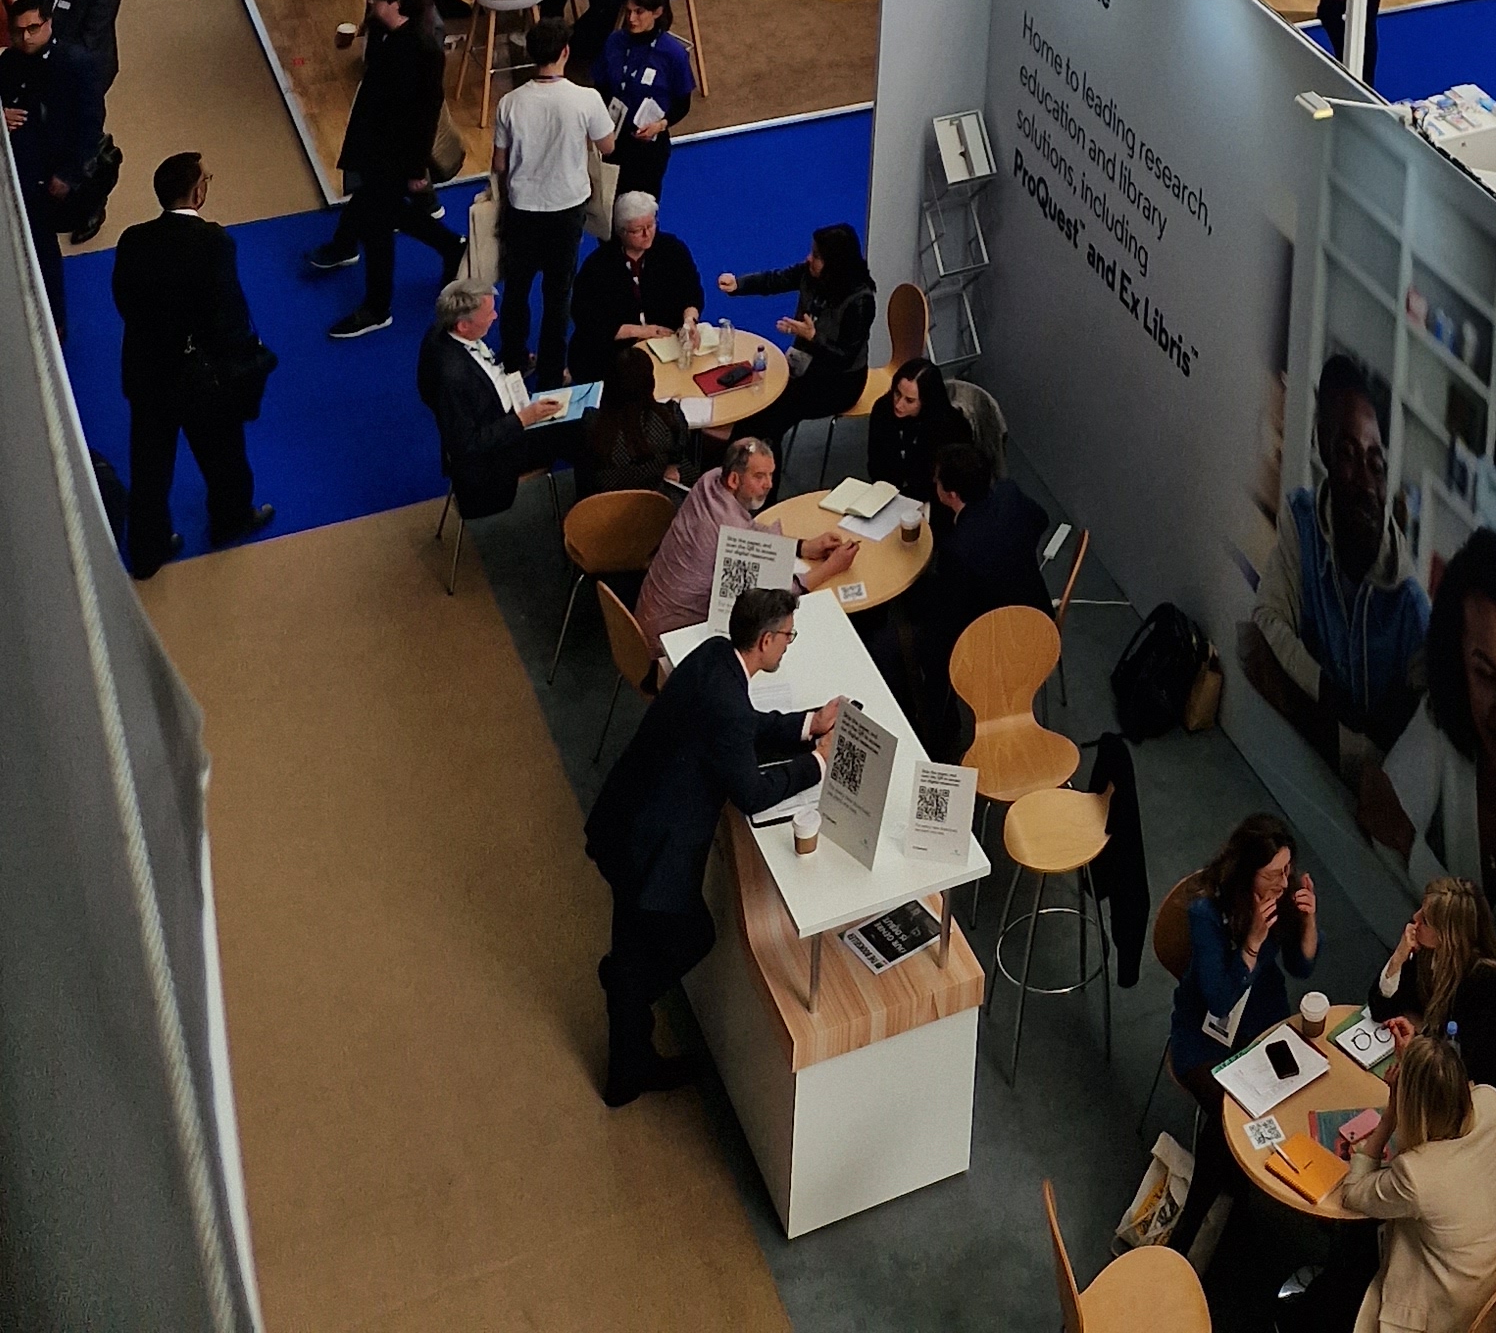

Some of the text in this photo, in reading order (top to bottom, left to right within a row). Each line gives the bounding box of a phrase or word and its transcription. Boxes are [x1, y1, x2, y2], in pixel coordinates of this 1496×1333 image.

[1016, 109, 1149, 277] solutions, including
[1019, 65, 1169, 241] education and library
[1023, 11, 1214, 236] Home to leading research,
[1086, 240, 1117, 293] and
[1119, 273, 1142, 321] Ex
